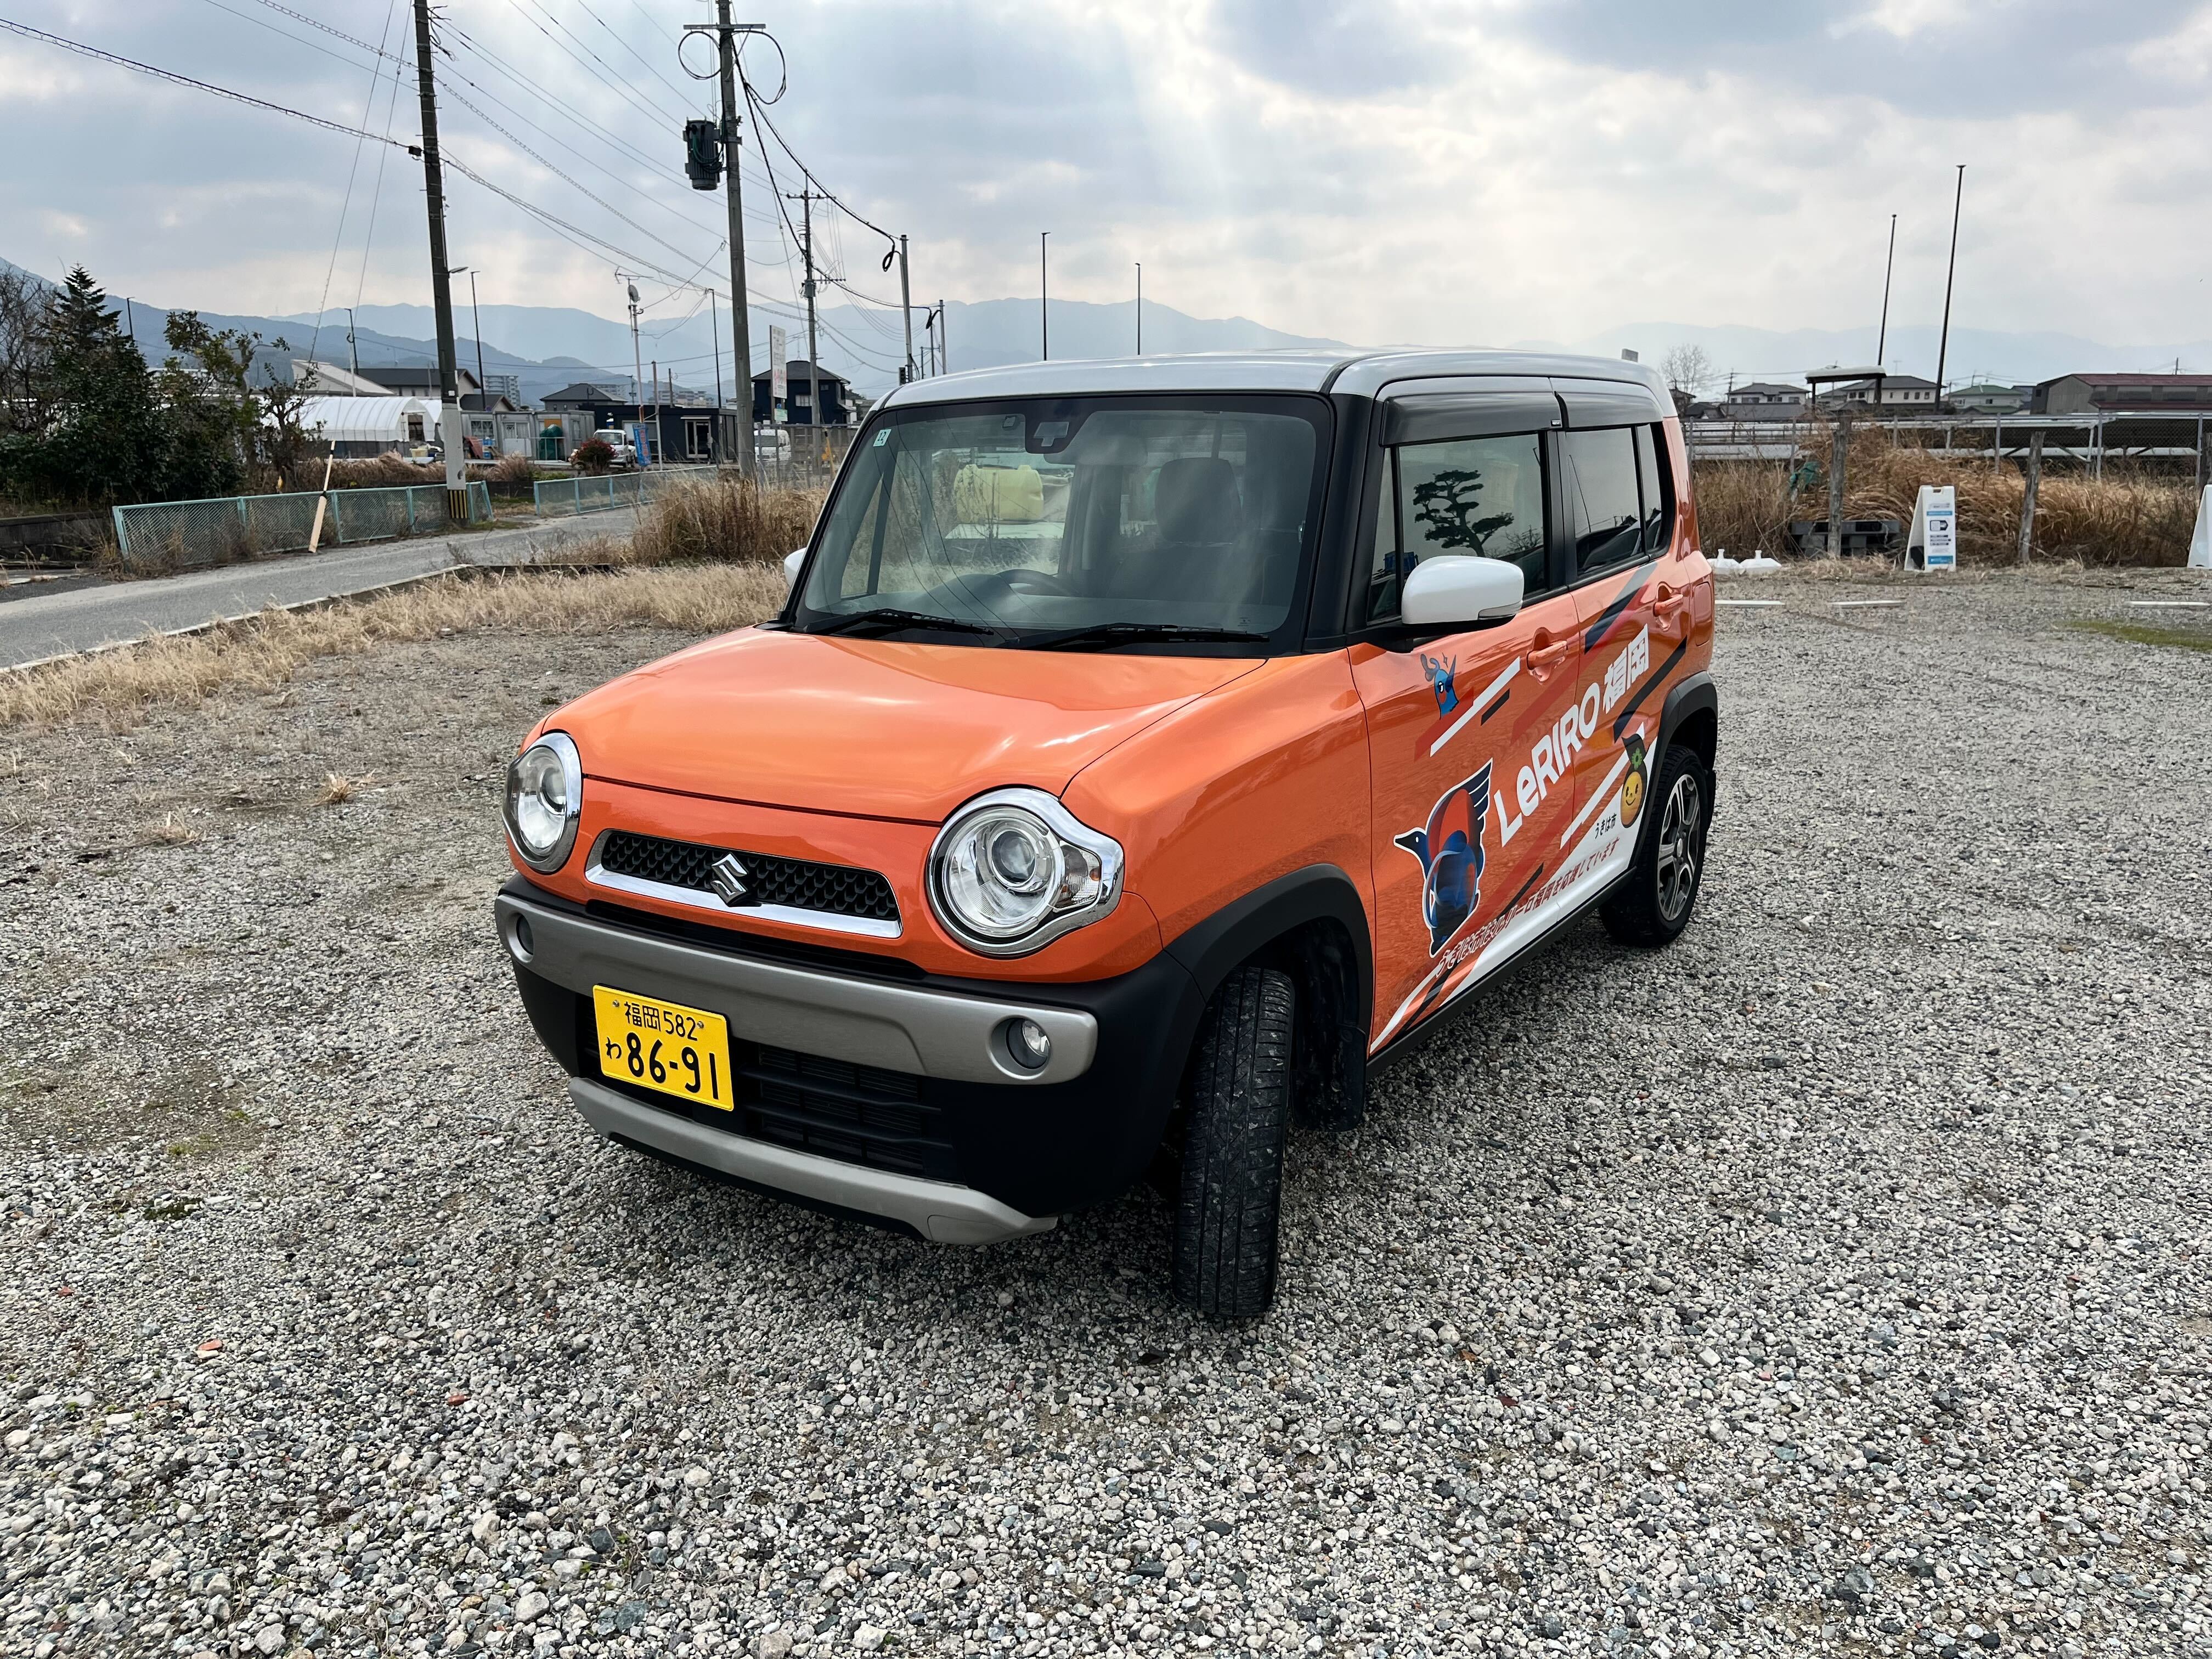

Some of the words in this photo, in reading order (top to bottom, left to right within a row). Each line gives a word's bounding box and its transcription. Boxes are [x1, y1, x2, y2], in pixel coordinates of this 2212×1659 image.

[1493, 682, 1601, 848] LeRIRO
[1602, 623, 1649, 714] 福岡
[1595, 813, 1617, 839] うきは市
[626, 1032, 719, 1100] 86-91
